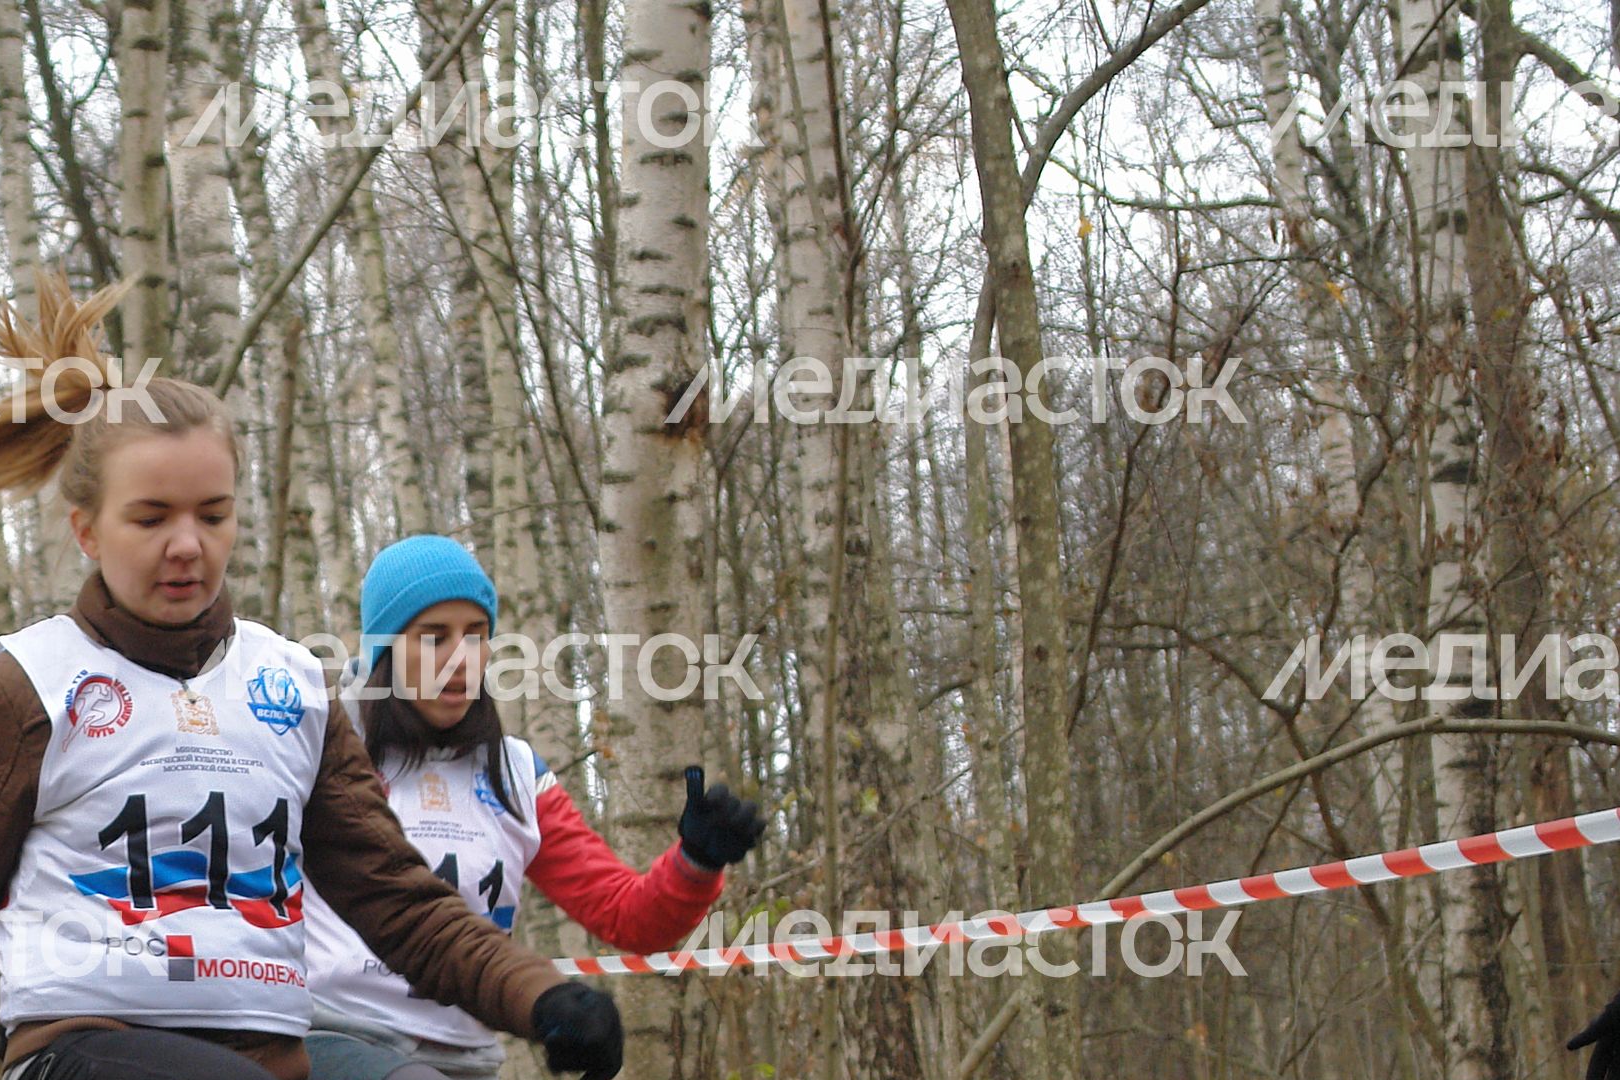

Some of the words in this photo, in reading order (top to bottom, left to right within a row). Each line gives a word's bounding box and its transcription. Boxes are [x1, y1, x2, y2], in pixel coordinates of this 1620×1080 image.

[87, 726, 116, 738] ПУТЬ
[98, 790, 291, 920] 111
[105, 936, 166, 957] РОС
[197, 958, 305, 988] МОЛОДЕЖЬ
[363, 958, 405, 977] РО
